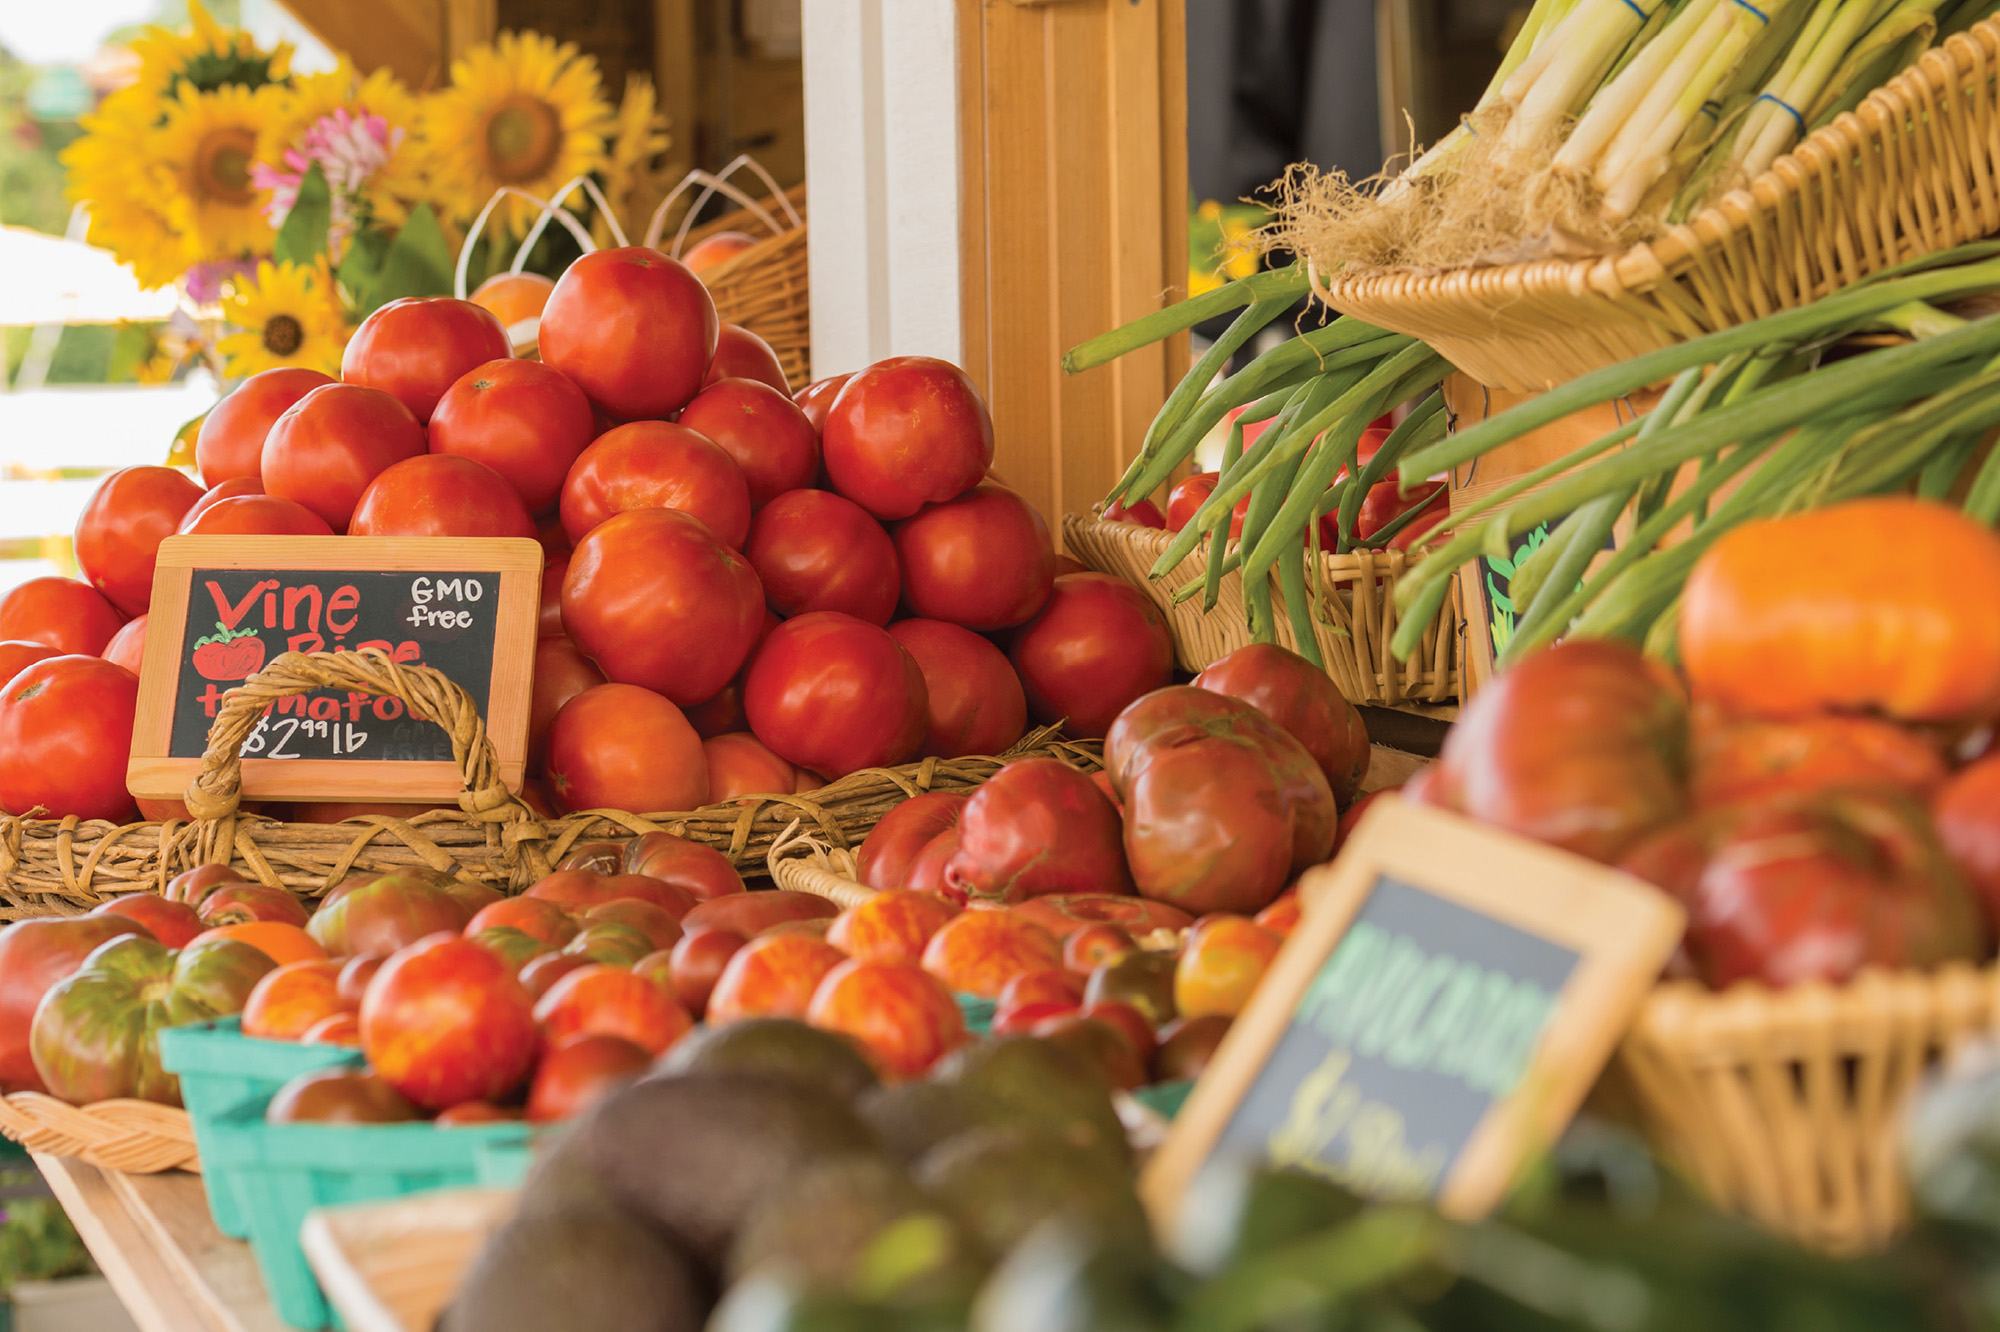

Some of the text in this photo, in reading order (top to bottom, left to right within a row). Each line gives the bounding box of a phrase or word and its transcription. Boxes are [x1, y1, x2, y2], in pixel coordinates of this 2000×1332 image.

[411, 576, 483, 603] GMO
[205, 579, 360, 634] Vine
[406, 604, 474, 630] free
[332, 722, 368, 754] lb
